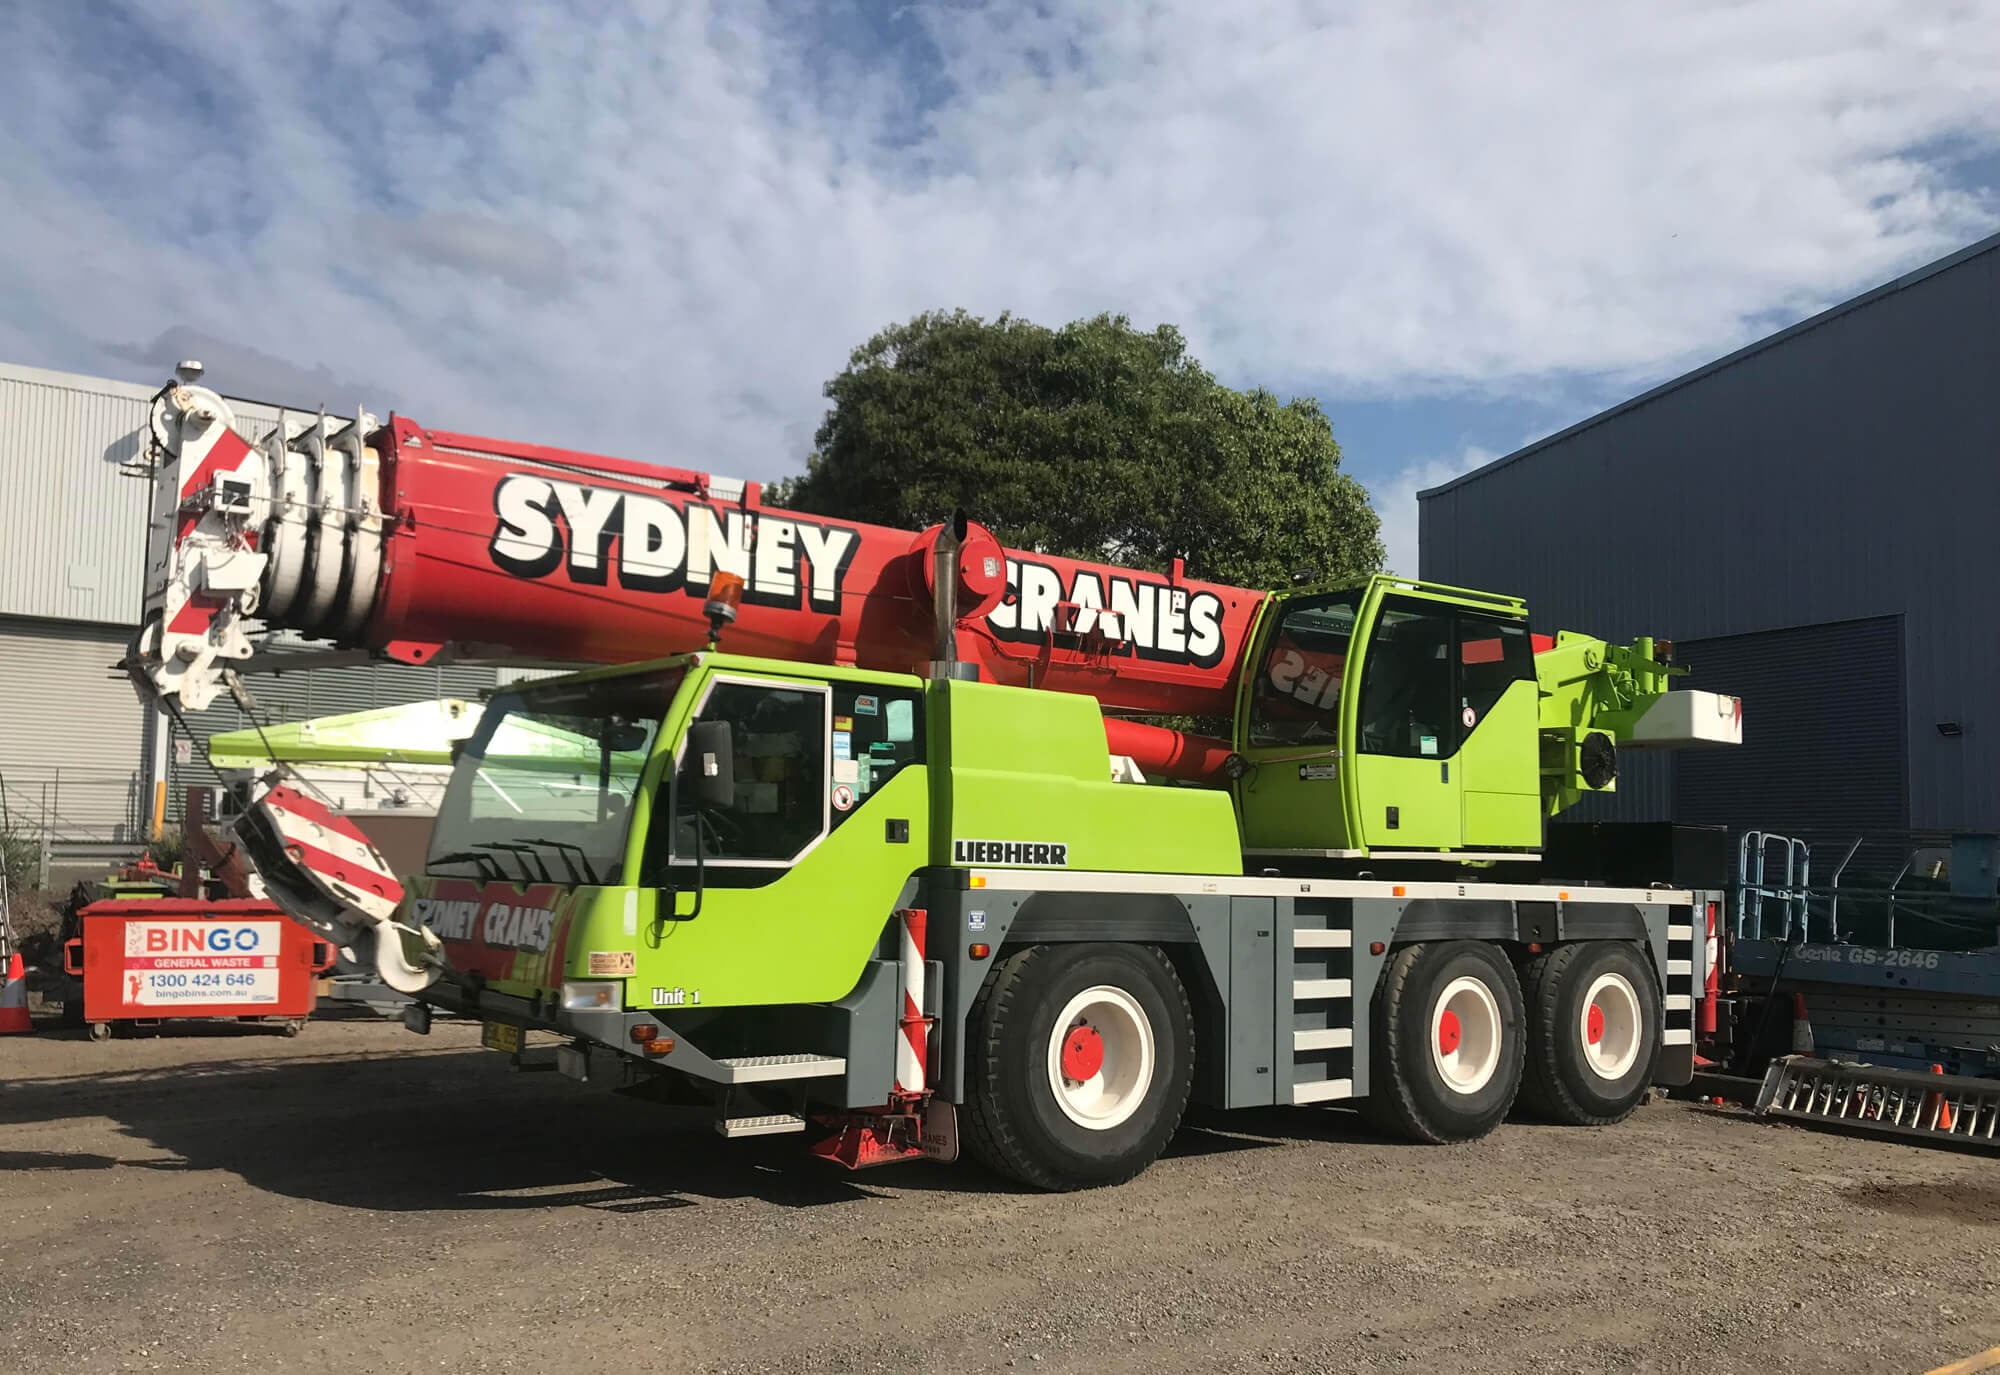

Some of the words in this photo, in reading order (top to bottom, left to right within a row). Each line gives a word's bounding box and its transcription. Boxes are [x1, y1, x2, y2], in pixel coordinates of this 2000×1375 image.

[491, 474, 861, 613] SYDNEY
[955, 840, 1067, 865] LIEBHERR
[483, 902, 556, 952] CRANES
[147, 928, 259, 952] BINGO
[154, 958, 208, 968] GENERAL
[212, 957, 251, 967] WASTE
[1794, 944, 1841, 962] Genie
[1849, 948, 1939, 969] GS-2646
[149, 973, 188, 988] 1300
[191, 973, 221, 987] 424
[225, 973, 256, 987] 646
[156, 989, 248, 999] bingobins.com.au
[651, 987, 686, 1006] Unit
[690, 989, 701, 1005] 1
